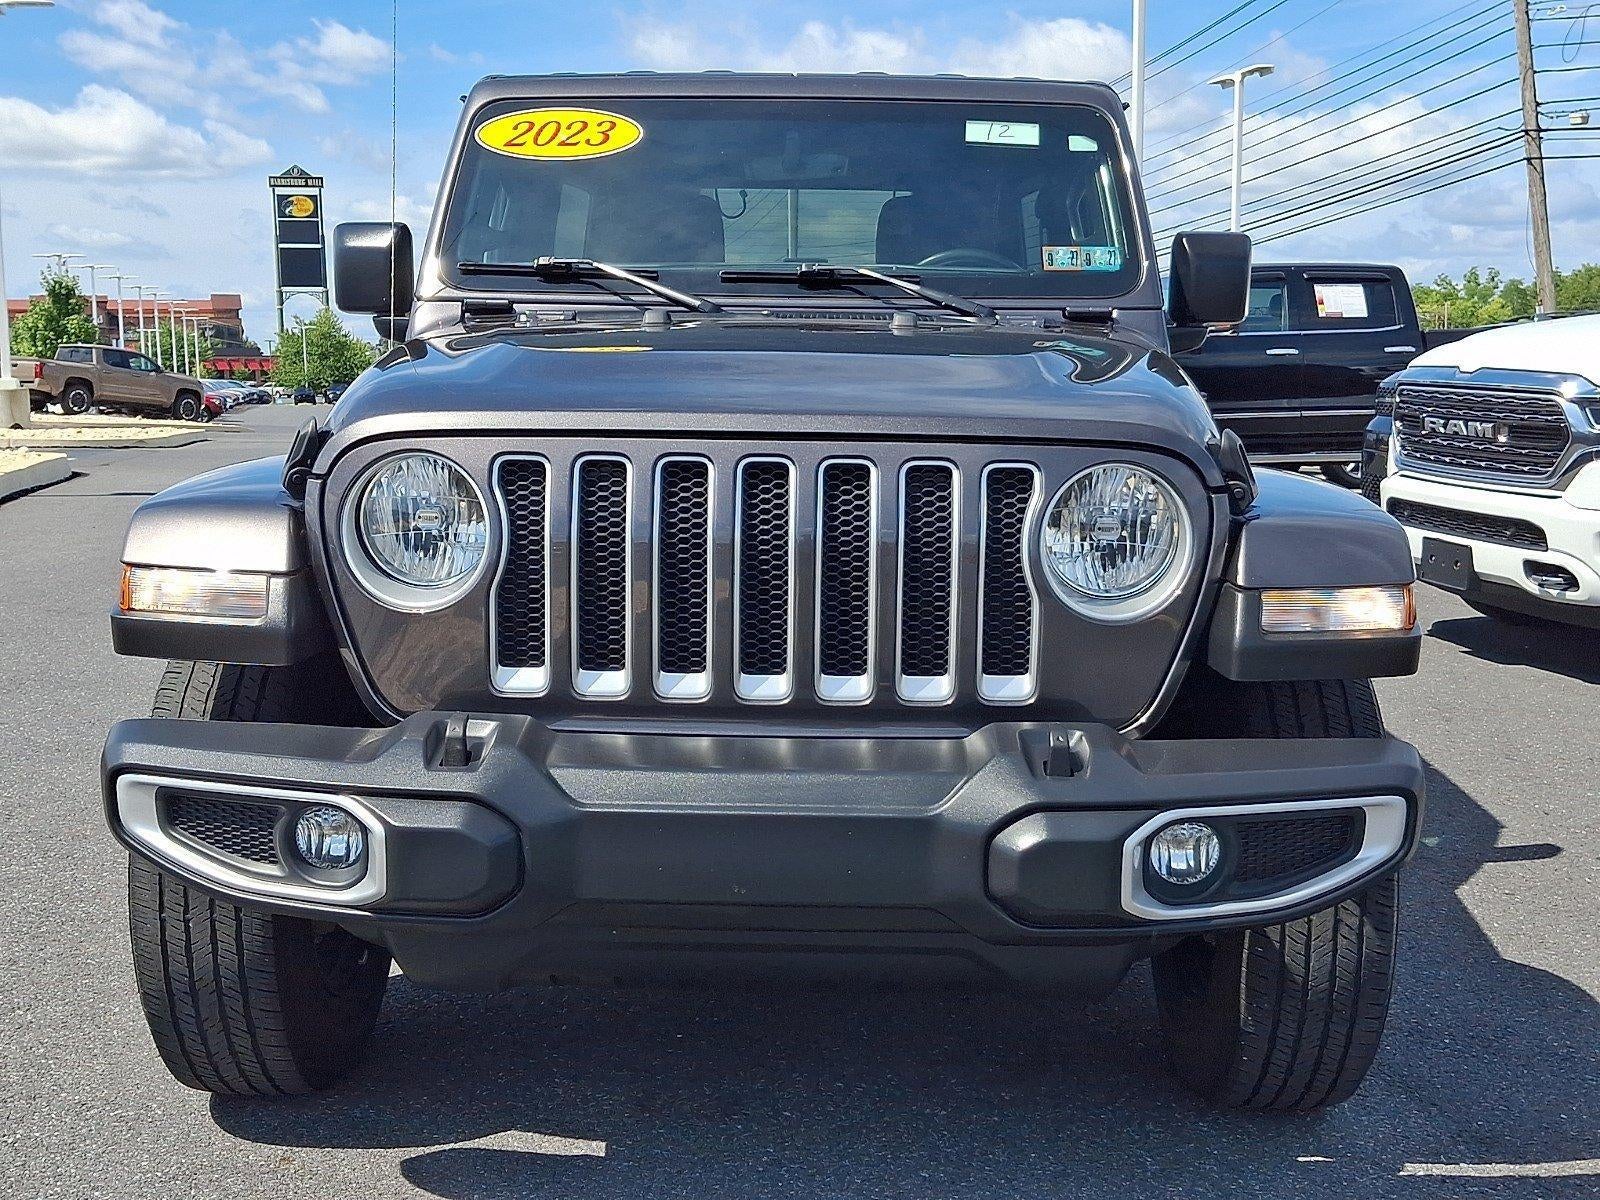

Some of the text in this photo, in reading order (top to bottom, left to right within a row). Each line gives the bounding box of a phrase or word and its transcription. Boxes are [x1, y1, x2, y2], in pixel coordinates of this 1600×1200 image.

[503, 120, 617, 147] 2023
[987, 123, 1015, 140] 12
[1047, 249, 1079, 267] 9 27
[1085, 249, 1116, 267] 9 27
[1424, 417, 1495, 438] RAM
